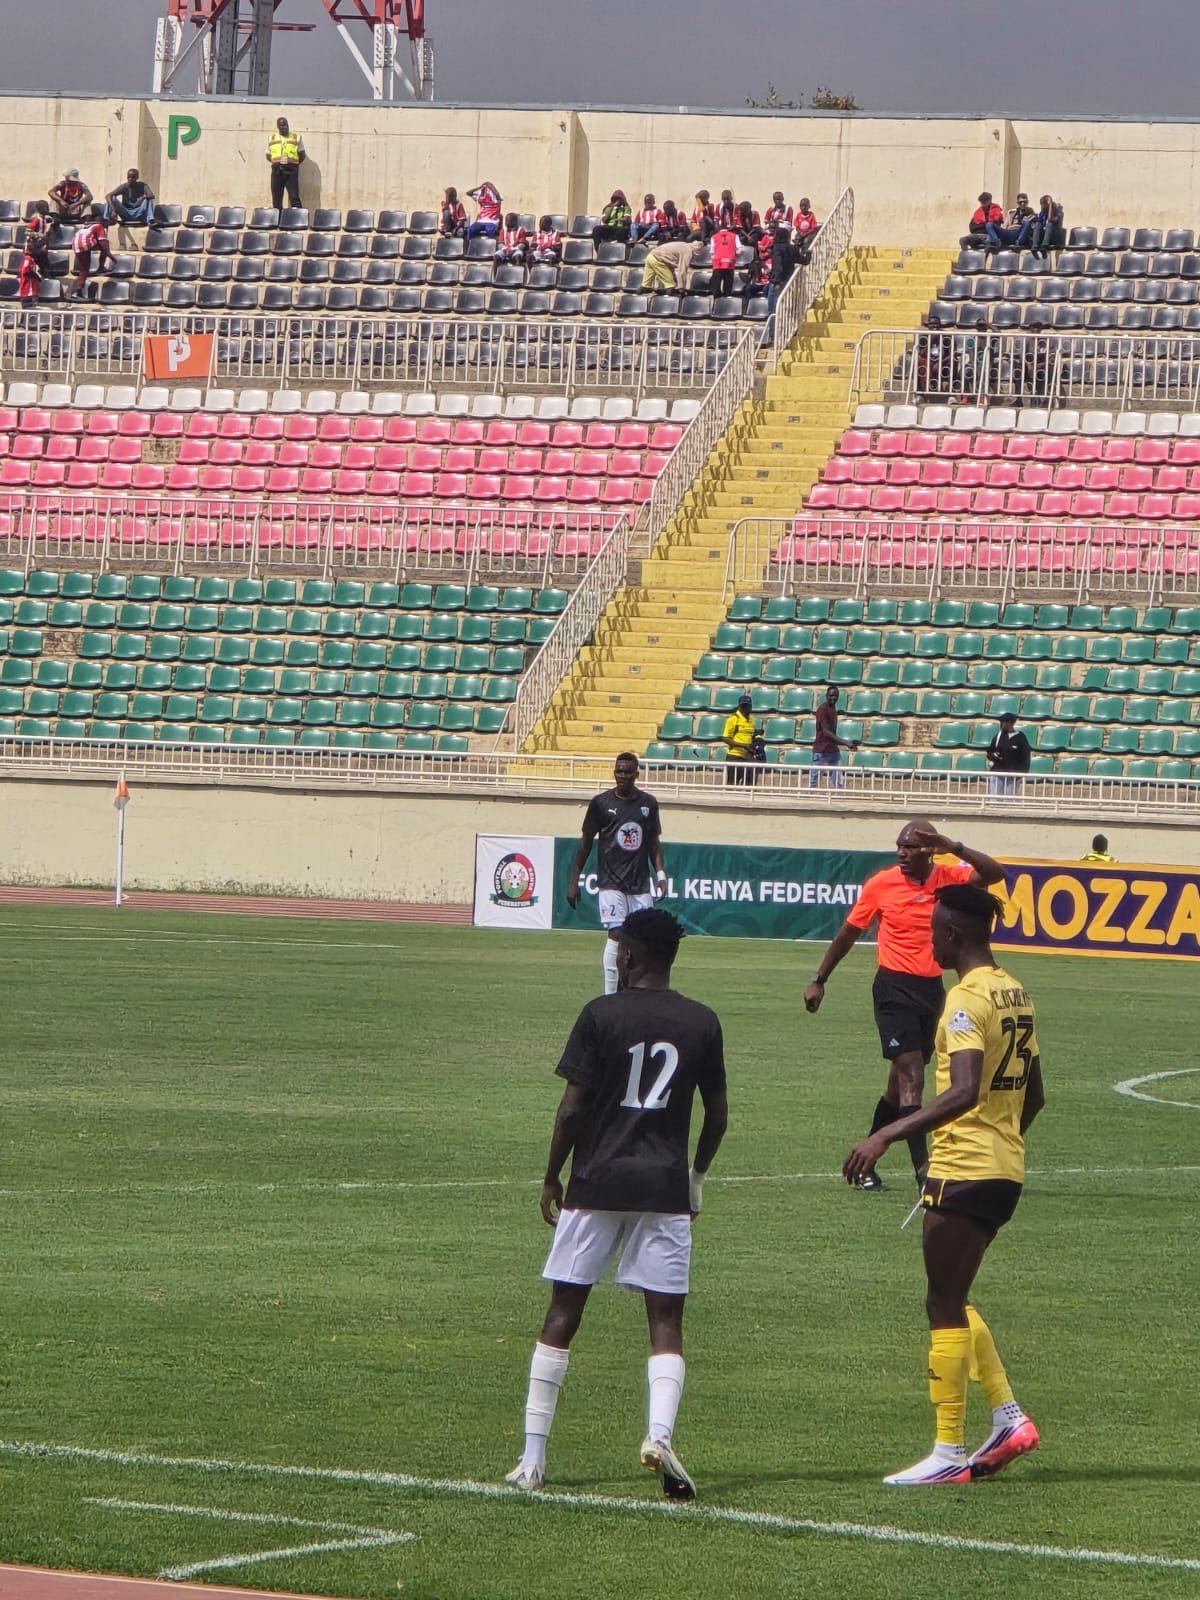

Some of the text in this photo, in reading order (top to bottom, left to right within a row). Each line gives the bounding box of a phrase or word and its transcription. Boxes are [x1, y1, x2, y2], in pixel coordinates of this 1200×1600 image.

[168, 115, 200, 157] P
[168, 335, 191, 372] P
[684, 878, 754, 902] KENYA
[760, 881, 864, 905] FEDERATI
[990, 1015, 1034, 1092] 23
[620, 1041, 679, 1109] 12
